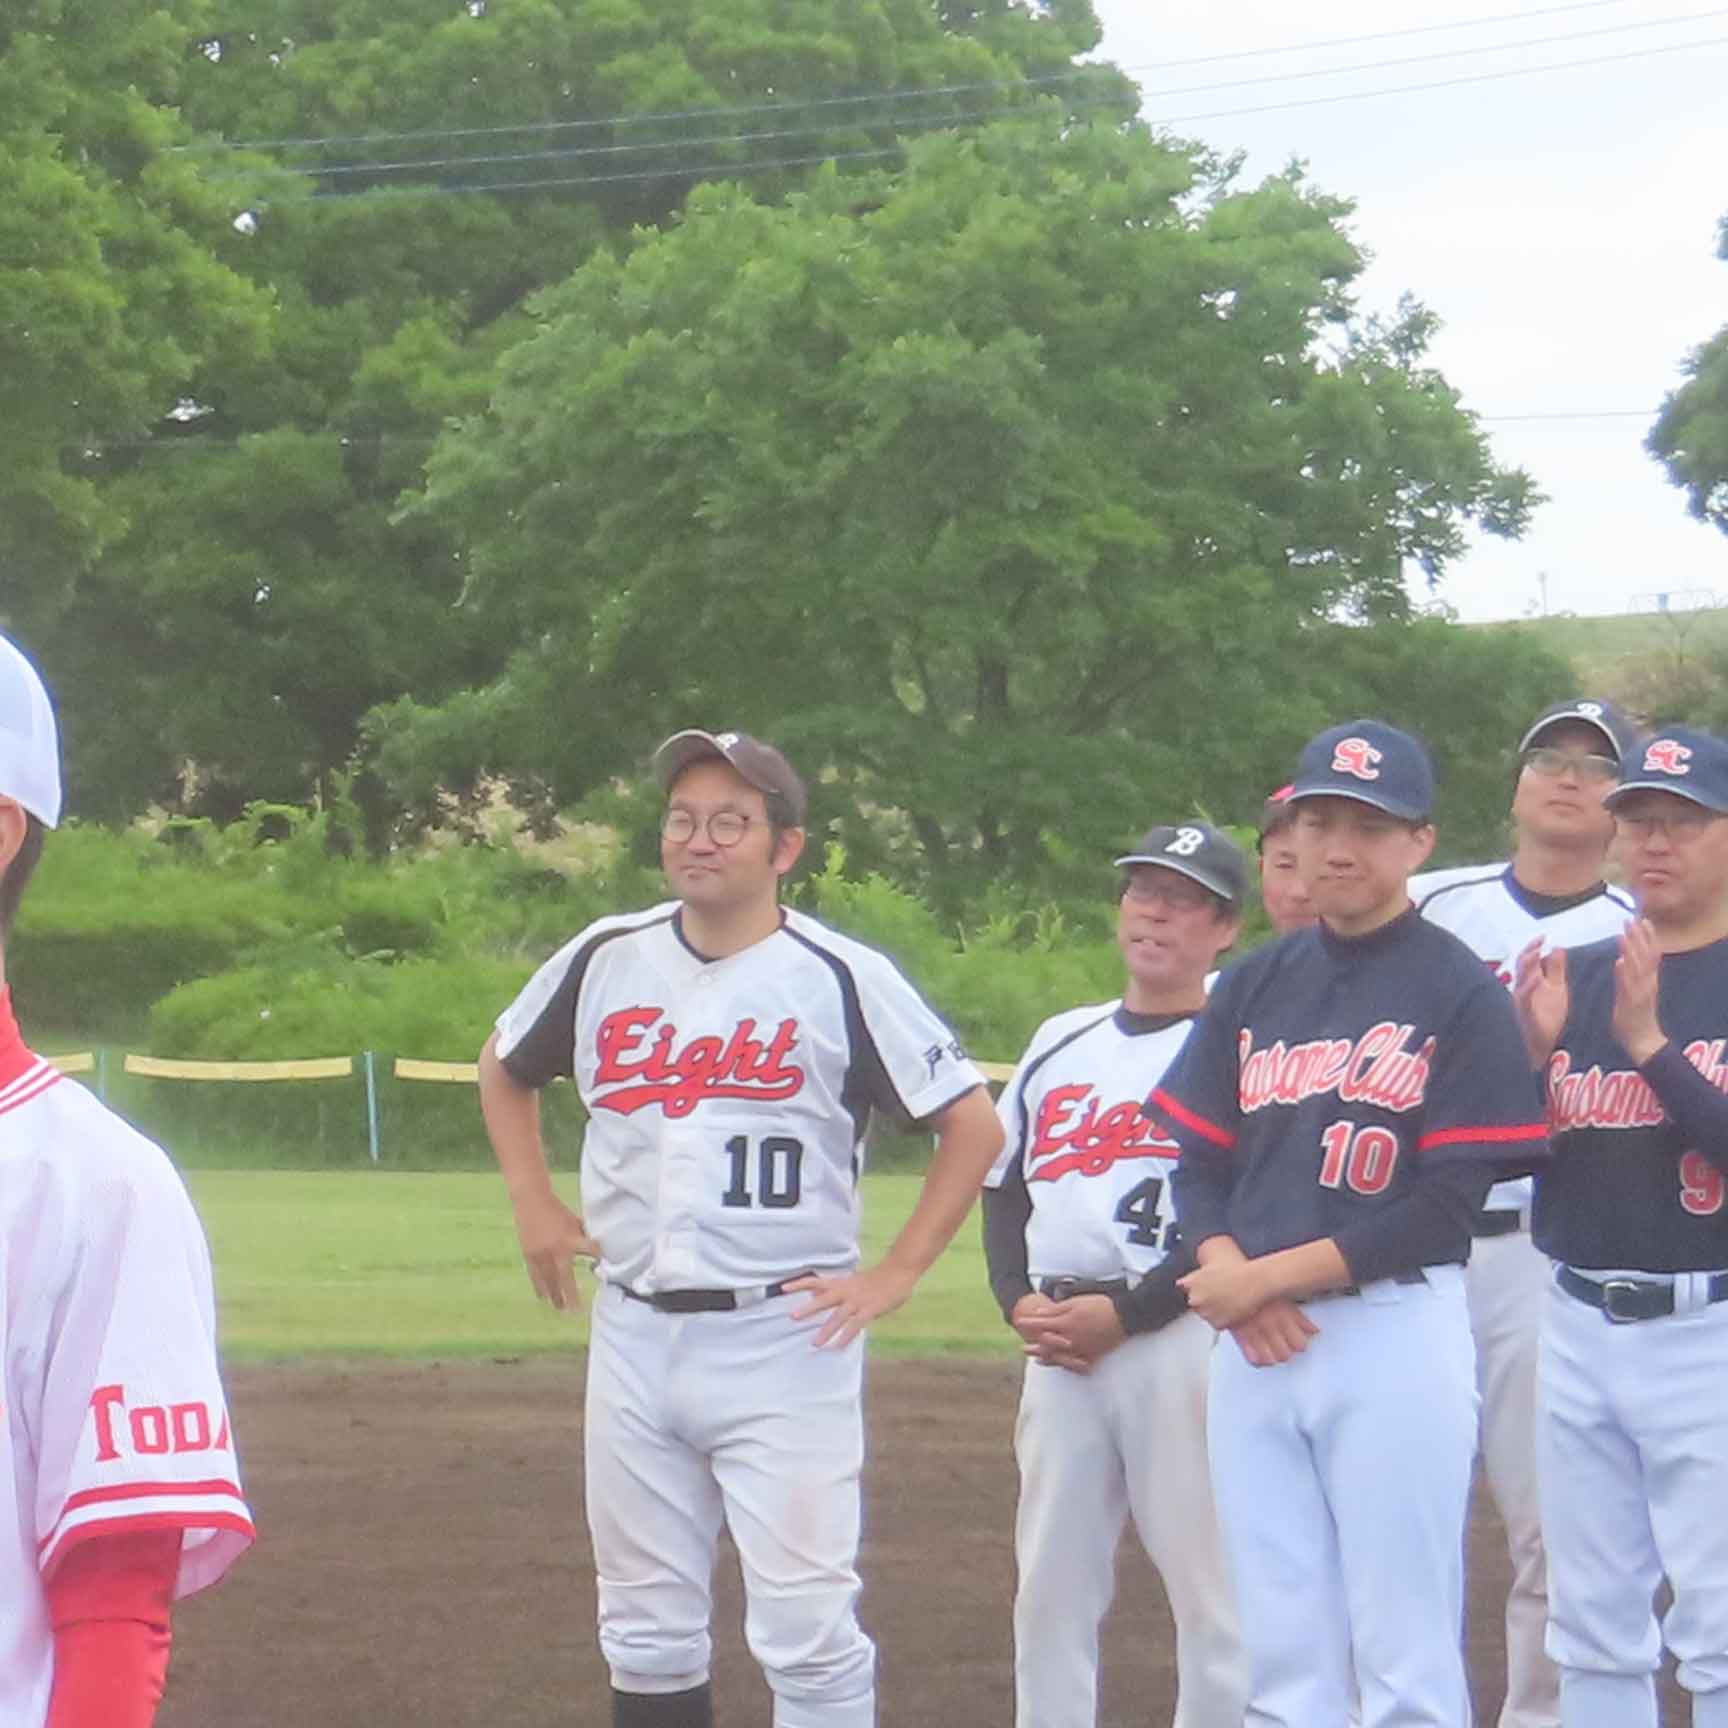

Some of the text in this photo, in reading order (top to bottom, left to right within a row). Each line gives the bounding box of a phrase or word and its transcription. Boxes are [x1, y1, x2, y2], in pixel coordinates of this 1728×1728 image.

[1165, 826, 1204, 855] B
[591, 1003, 804, 1118] Eight
[1025, 1082, 1184, 1183] Eig
[1318, 1119, 1399, 1194] 10
[721, 1135, 804, 1209] 10
